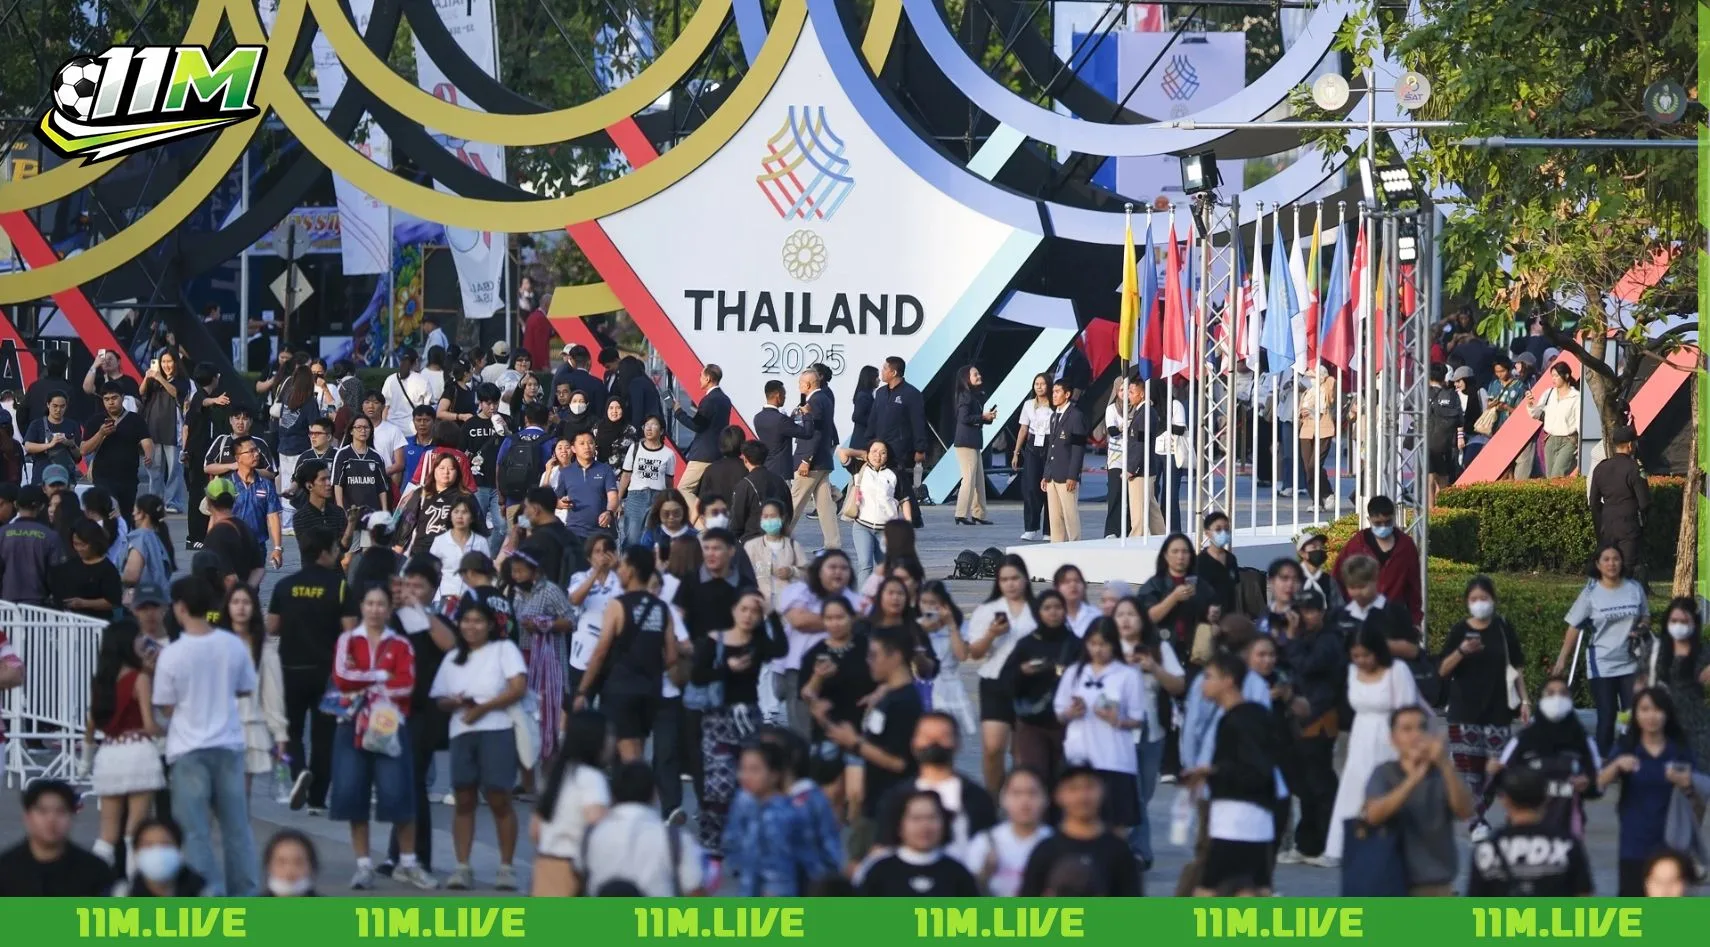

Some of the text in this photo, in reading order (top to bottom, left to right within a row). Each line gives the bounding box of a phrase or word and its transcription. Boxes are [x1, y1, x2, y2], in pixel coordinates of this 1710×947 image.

[684, 289, 925, 336] THAILAND
[760, 341, 846, 376] 2025
[469, 427, 497, 438] CELIN
[347, 476, 376, 485] THAILAND
[292, 585, 325, 599] STAFF
